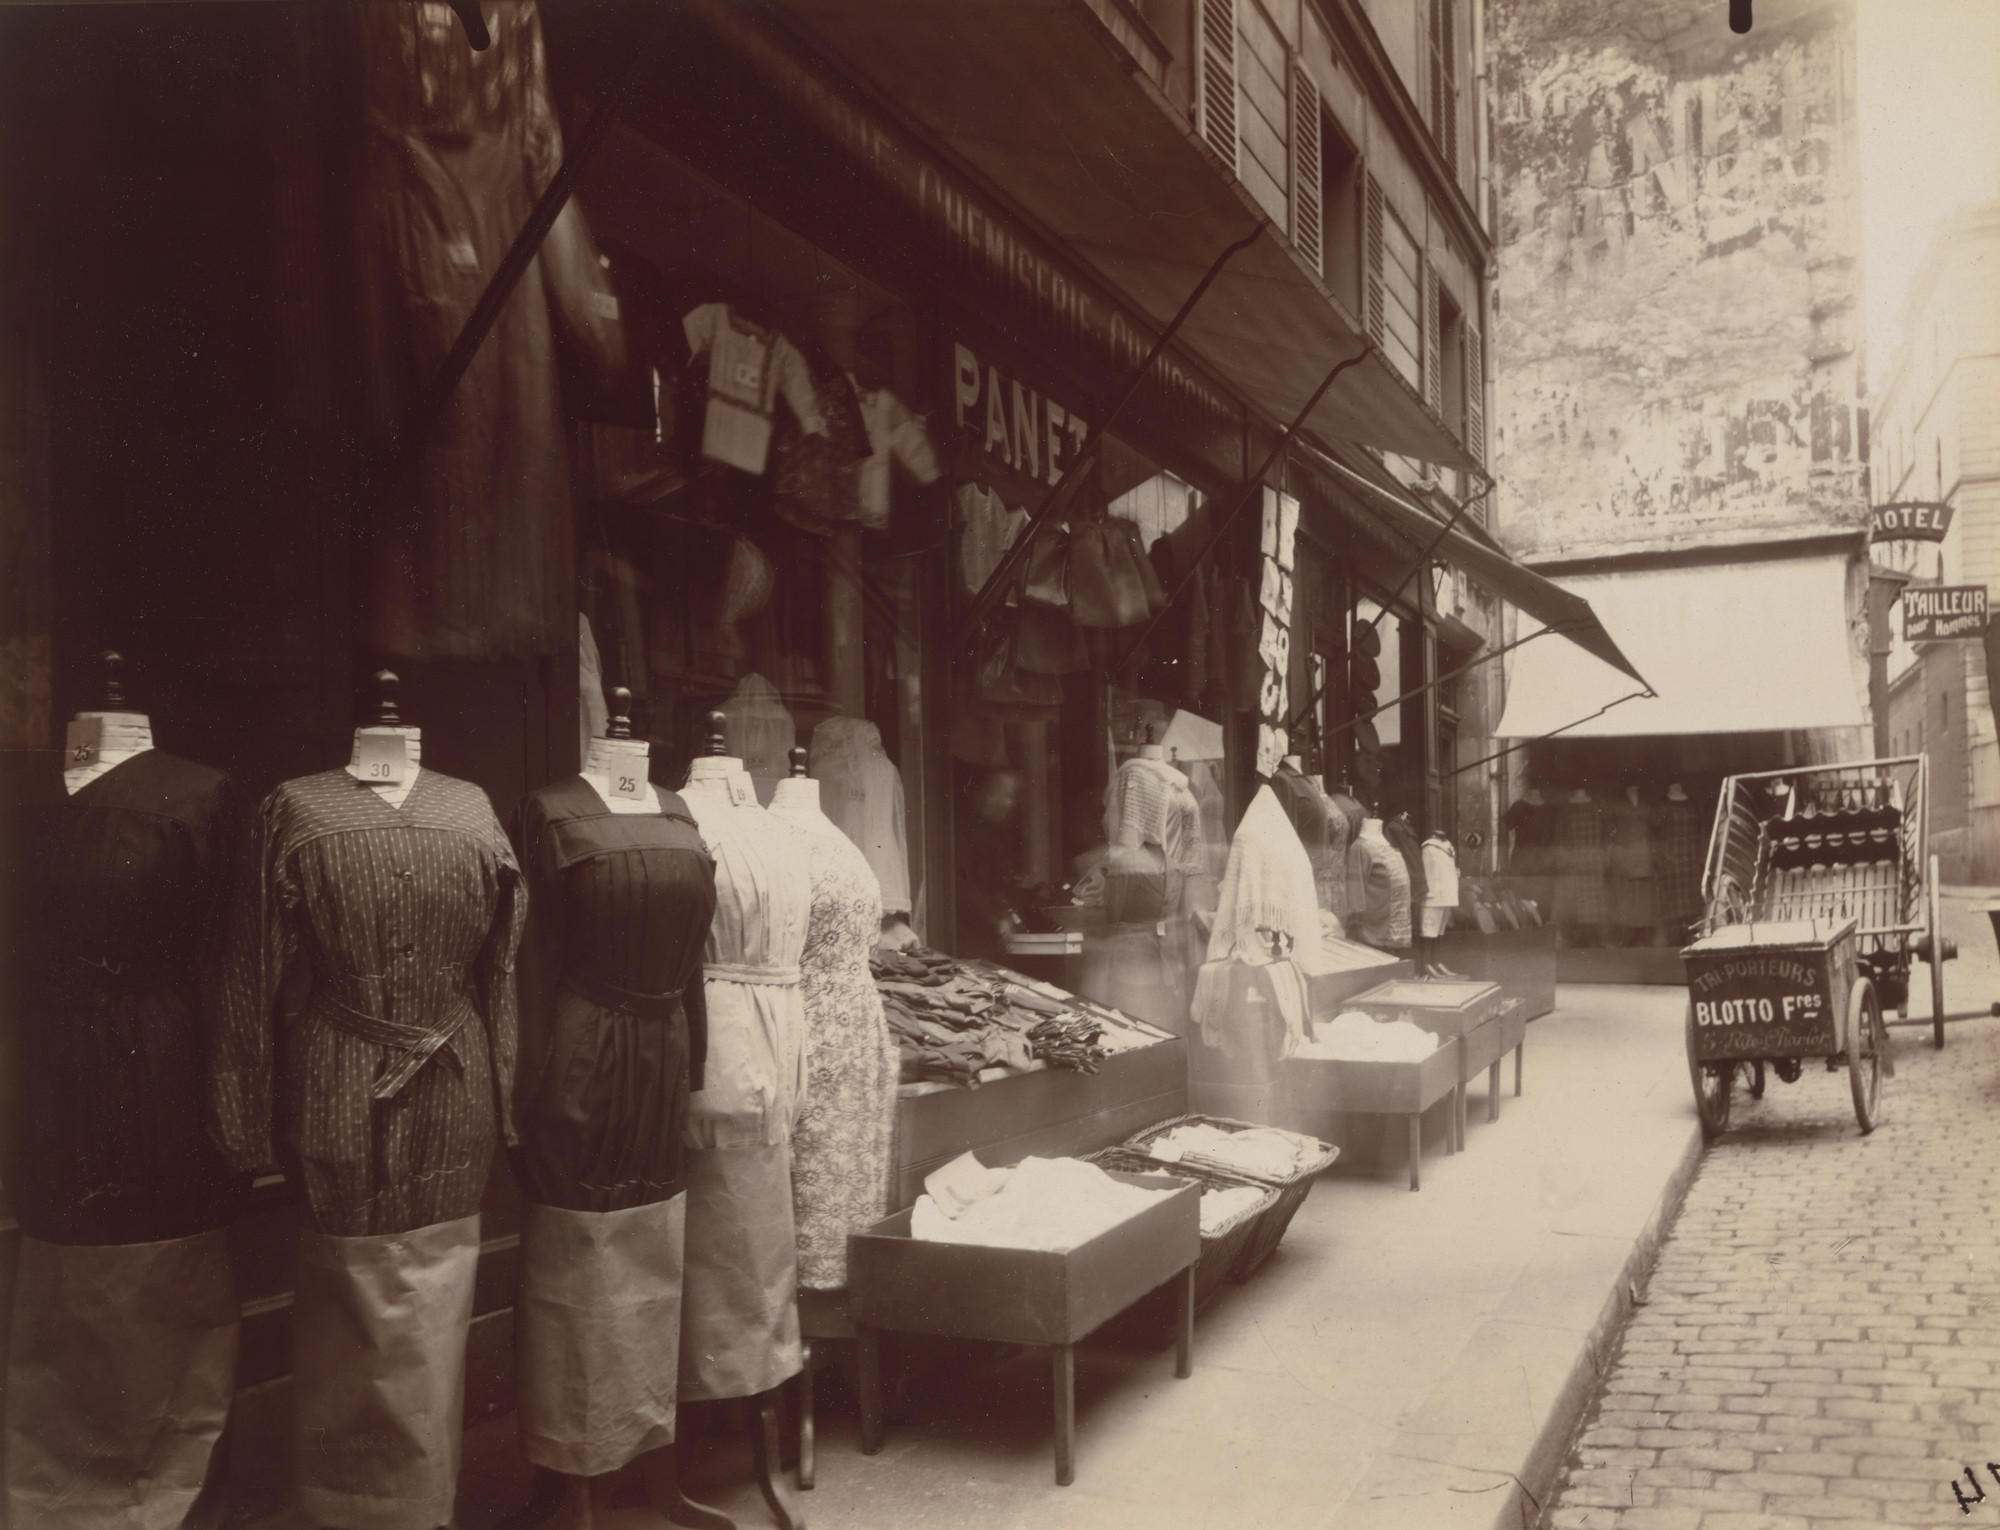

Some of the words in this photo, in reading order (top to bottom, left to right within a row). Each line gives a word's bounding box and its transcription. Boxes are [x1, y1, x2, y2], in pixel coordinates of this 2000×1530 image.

[1904, 590, 1985, 618] TAILLEUR
[1906, 618, 1929, 638] pour
[1935, 615, 1982, 636] Hommes
[74, 744, 89, 761] 25
[370, 762, 391, 778] 30
[618, 776, 635, 792] 25
[1695, 958, 1817, 993] TRI-PORTEURS
[1696, 997, 1775, 1026] BLOTTO
